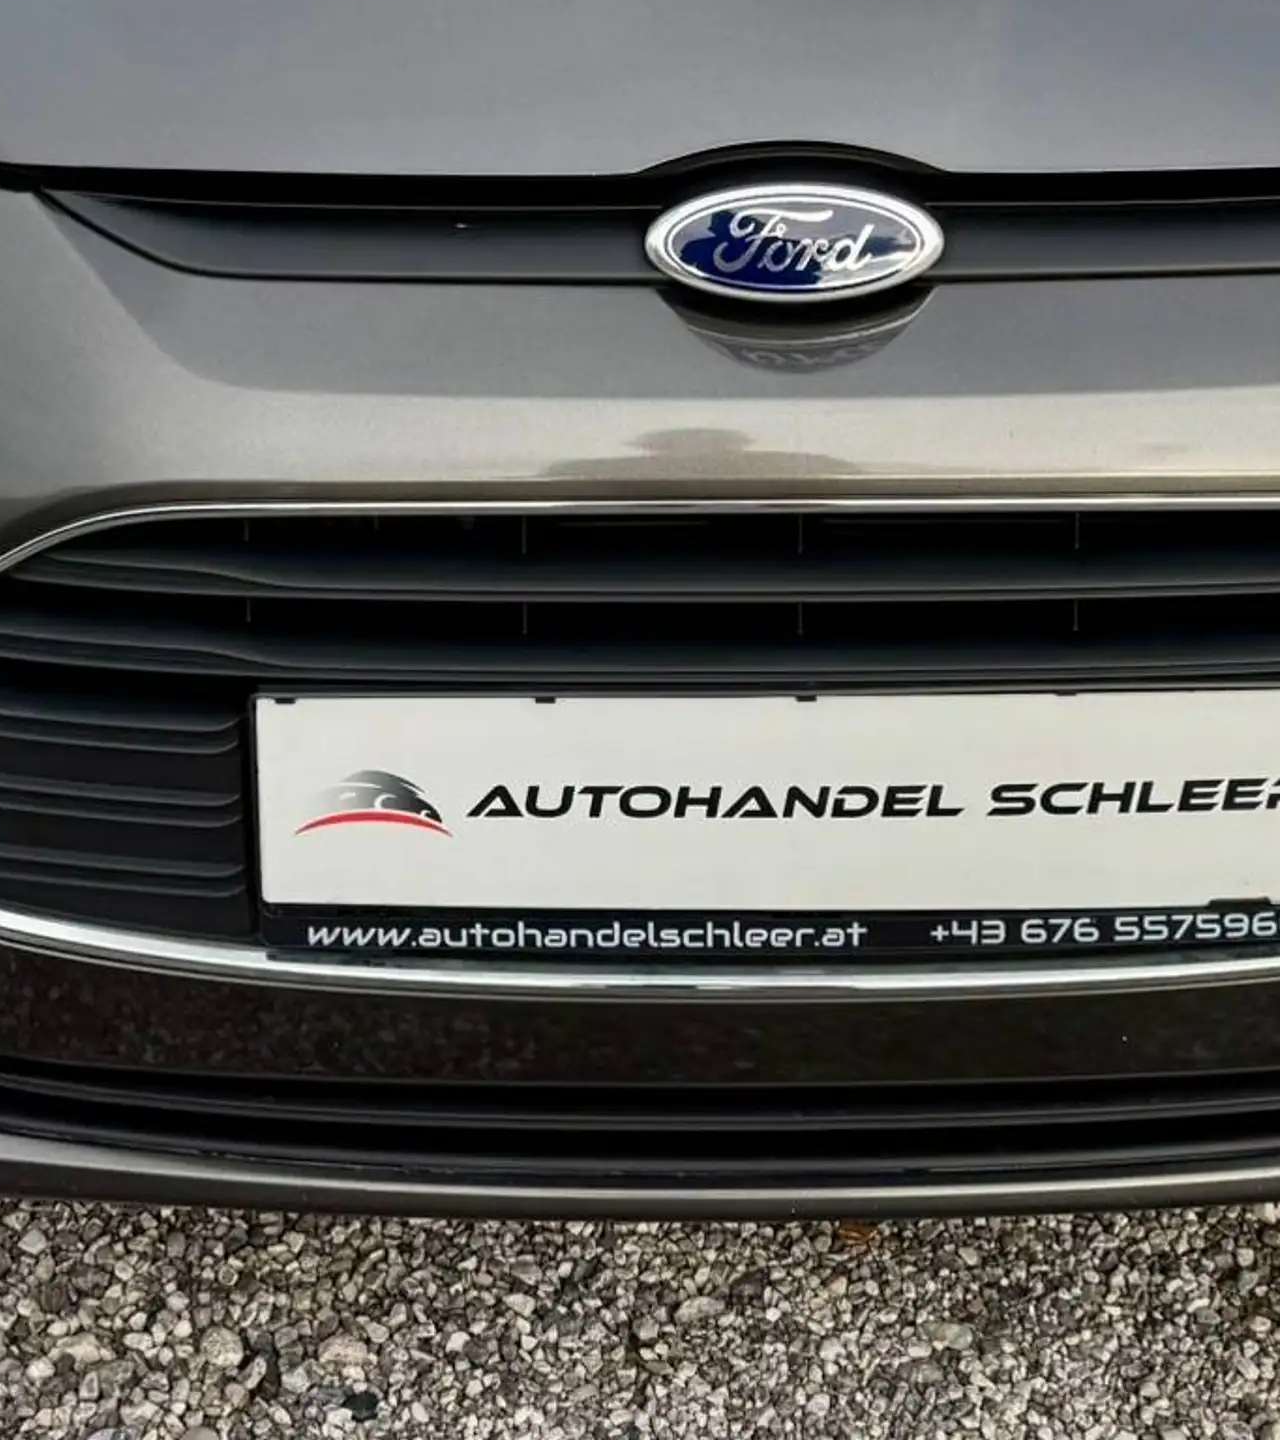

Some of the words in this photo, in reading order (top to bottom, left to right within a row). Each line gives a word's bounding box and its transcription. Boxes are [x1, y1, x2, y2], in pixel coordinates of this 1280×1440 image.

[713, 208, 874, 273] Ford
[466, 784, 964, 819] AUTOHANDEL
[307, 920, 868, 948] www.autohandelschleer.at
[930, 919, 1006, 946] +43
[1020, 917, 1100, 944] 676
